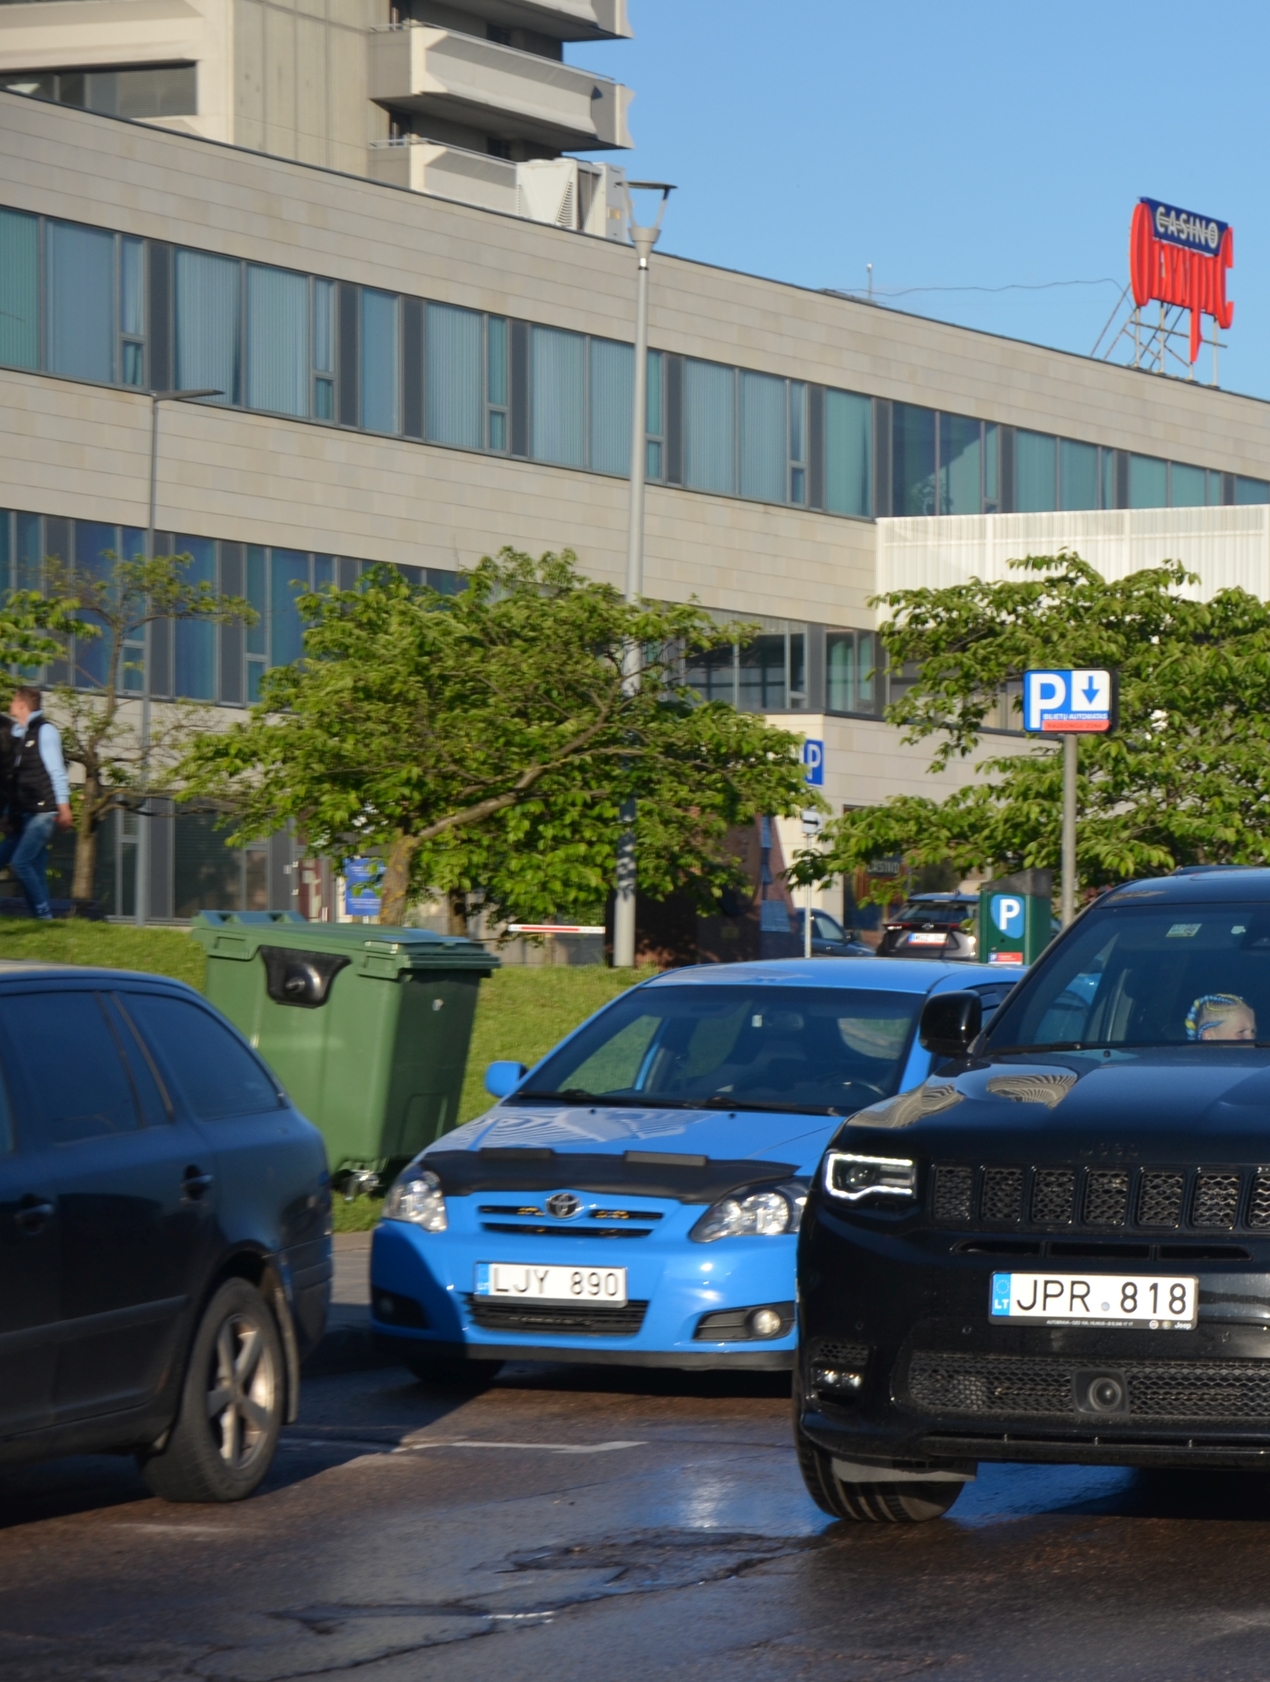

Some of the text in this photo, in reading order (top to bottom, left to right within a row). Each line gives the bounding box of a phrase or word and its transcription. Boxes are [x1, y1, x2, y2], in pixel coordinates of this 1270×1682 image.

[1155, 205, 1219, 249] CASINO
[1030, 673, 1066, 728] P
[807, 743, 822, 780] P
[999, 899, 1021, 930] P
[493, 1267, 619, 1297] LJY 890
[1016, 1279, 1187, 1315] JPR 818
[994, 1299, 1010, 1310] LT
[1174, 1321, 1193, 1331] Jeep
